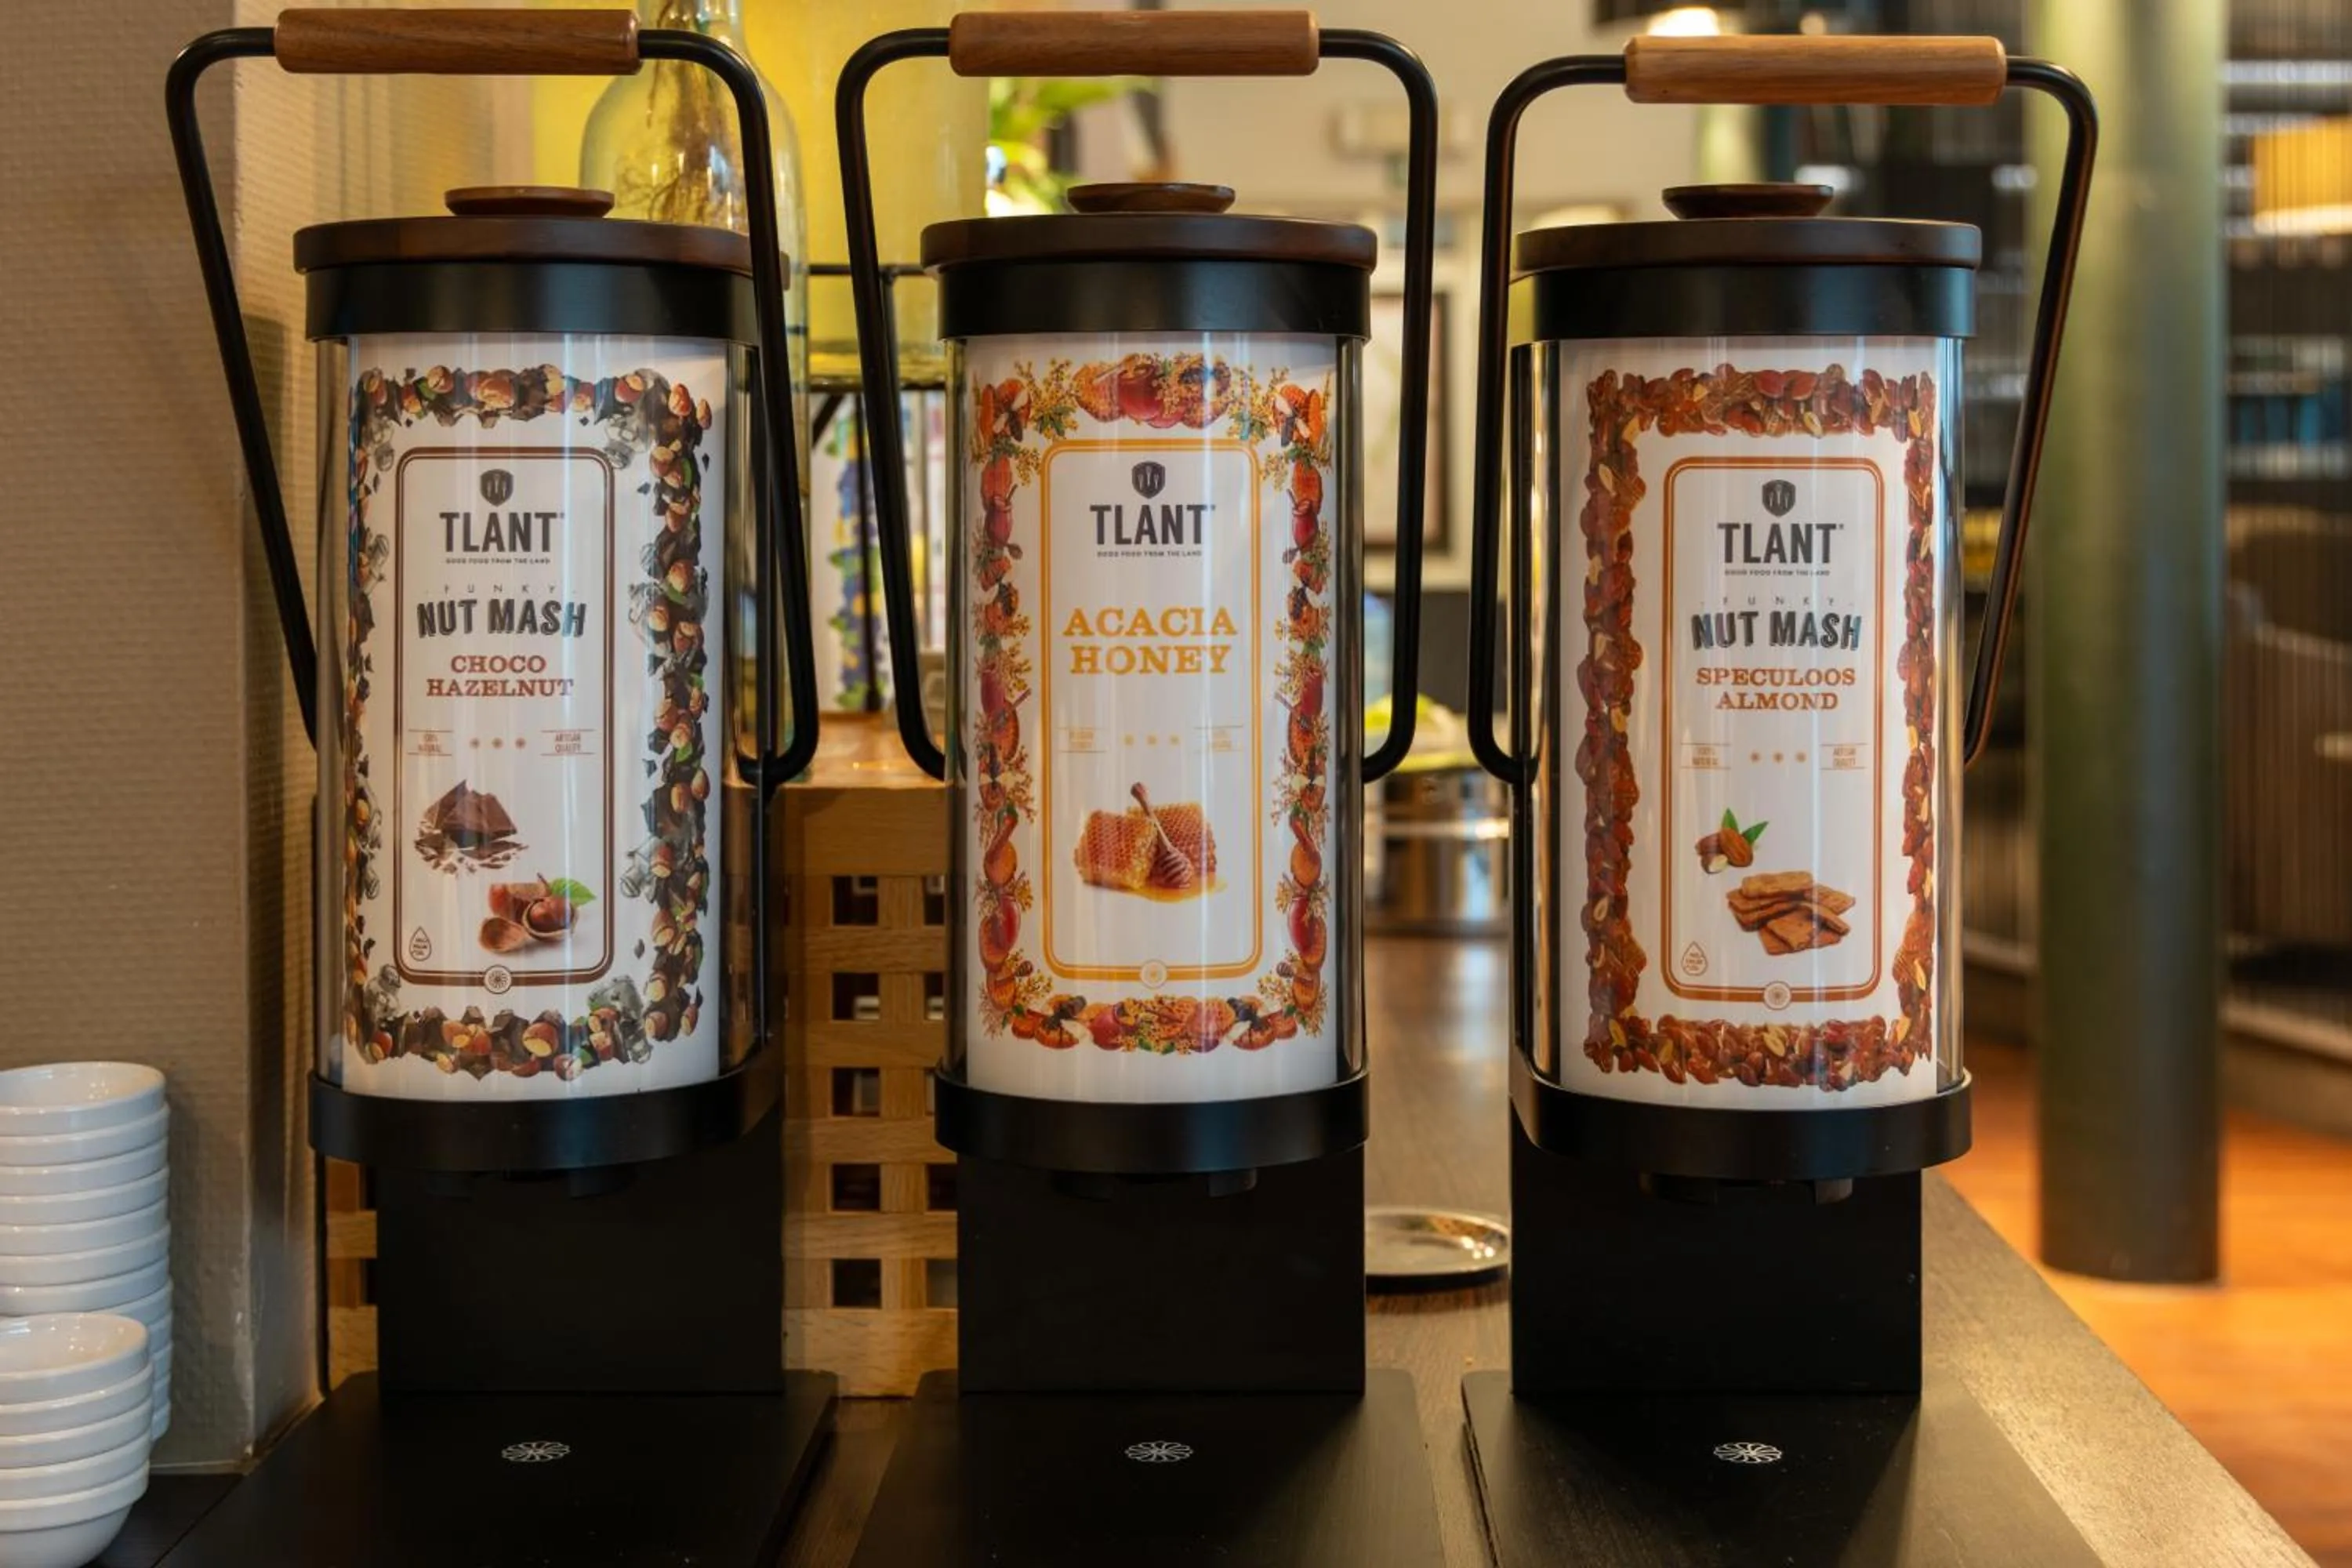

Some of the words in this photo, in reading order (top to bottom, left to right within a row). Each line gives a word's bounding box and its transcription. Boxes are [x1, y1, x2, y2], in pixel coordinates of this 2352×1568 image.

[439, 512, 557, 552] TLANT
[1090, 505, 1208, 545] TLANT
[1717, 523, 1837, 563] TLANT
[417, 599, 477, 638] NUT
[488, 599, 587, 637] MASH
[1062, 607, 1238, 637] ACACIA
[1691, 612, 1759, 650] NUT
[1769, 612, 1862, 650] MASH
[451, 655, 546, 673] CHOCO
[1070, 645, 1232, 675] HONEY
[426, 679, 574, 697] HAZELNUT
[1696, 667, 1855, 686] SPECULOOS
[1715, 692, 1838, 710] ALMOND
